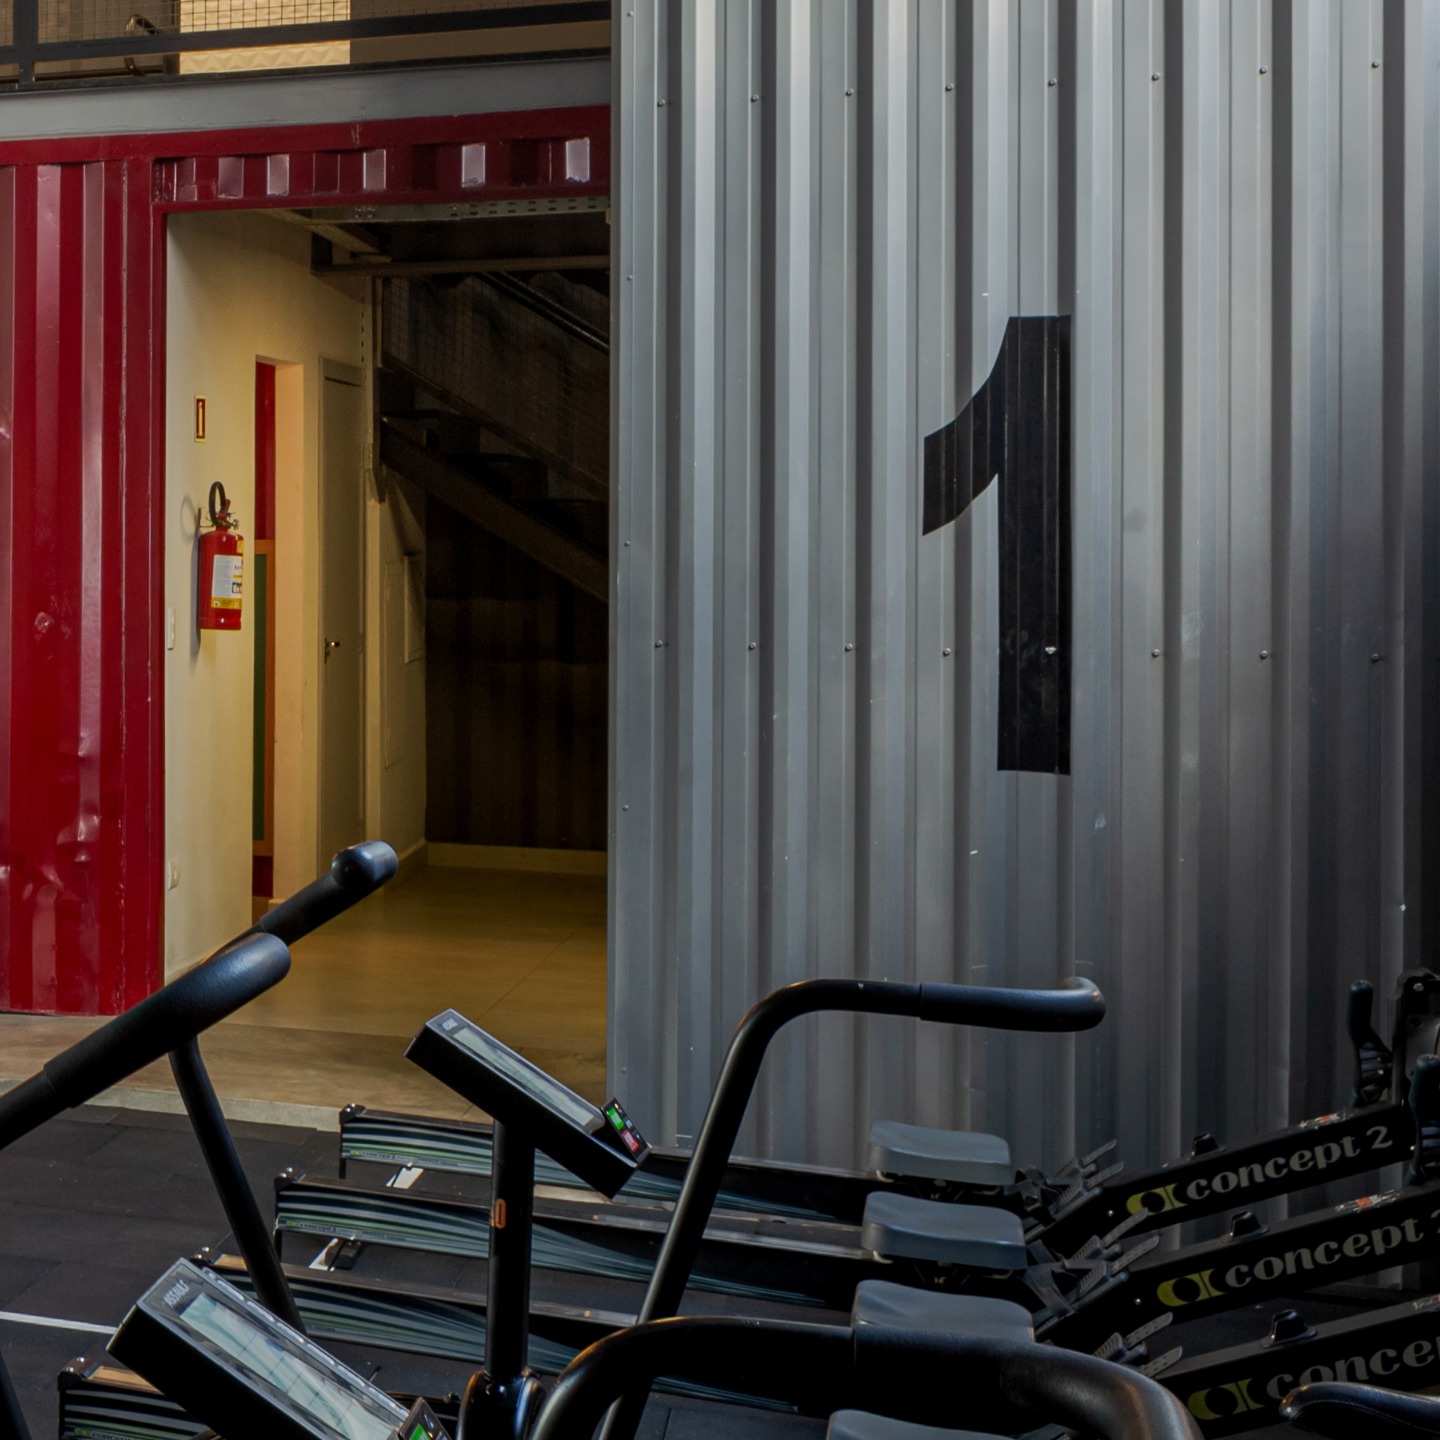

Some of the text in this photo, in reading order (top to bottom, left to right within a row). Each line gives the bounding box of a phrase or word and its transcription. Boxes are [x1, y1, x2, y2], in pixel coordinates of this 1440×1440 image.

[921, 315, 1072, 776] 1
[1186, 1134, 1361, 1201] concept
[1366, 1125, 1393, 1150] 2
[1225, 1217, 1424, 1288] concept
[1266, 1337, 1440, 1401] conce
